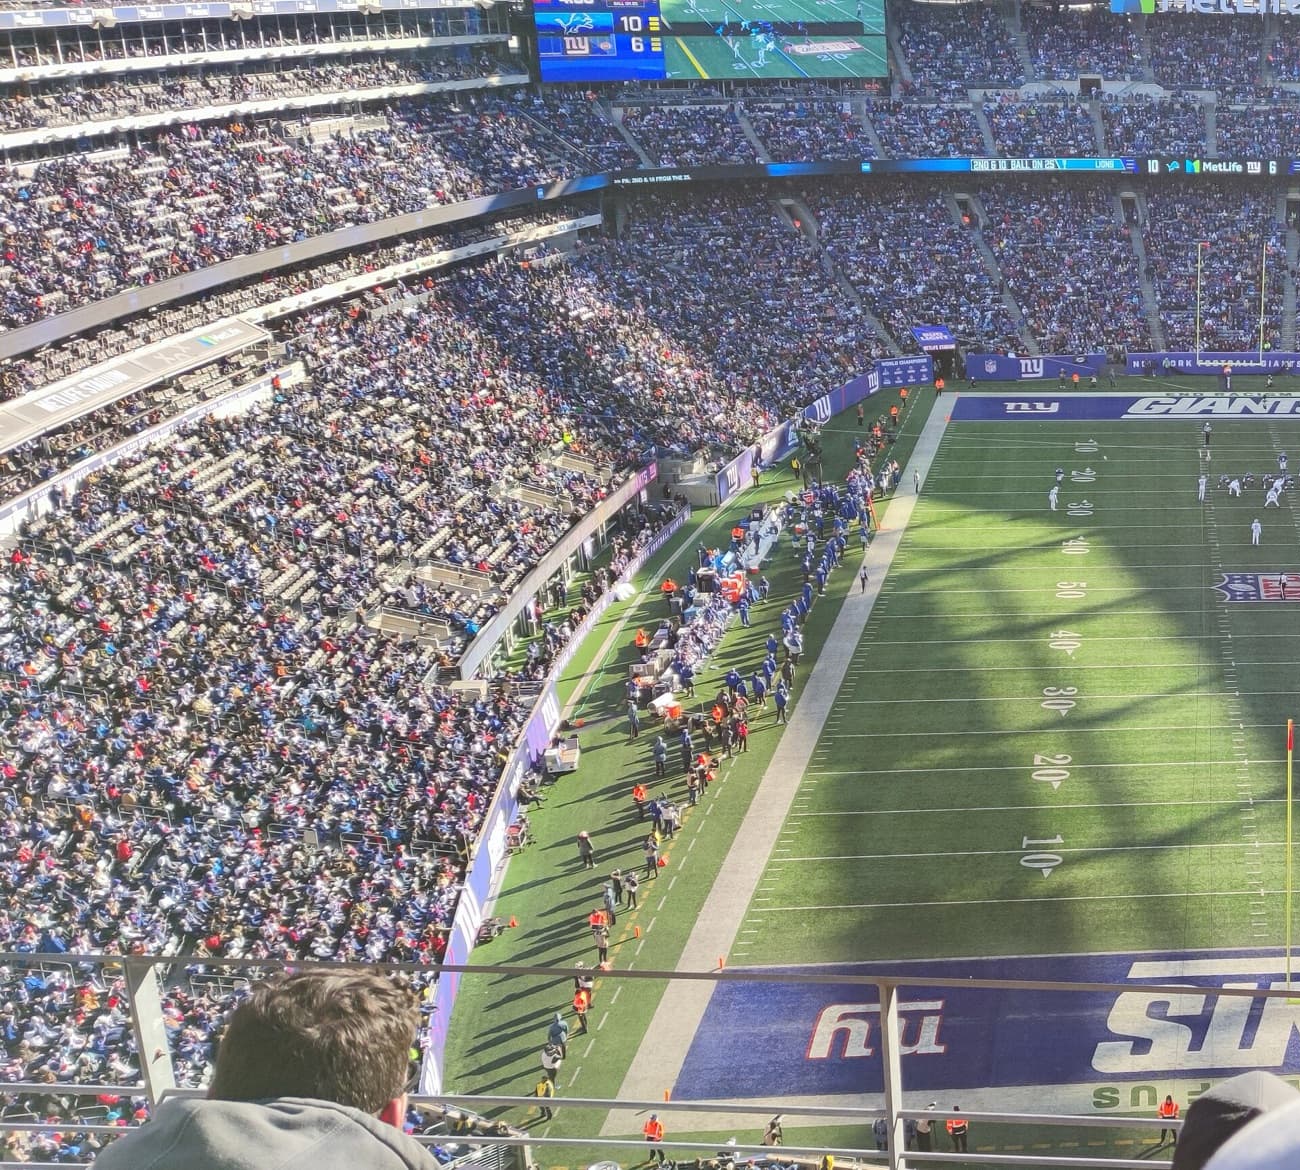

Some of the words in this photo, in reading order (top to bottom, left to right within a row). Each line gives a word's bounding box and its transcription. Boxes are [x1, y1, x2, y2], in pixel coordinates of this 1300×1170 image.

[620, 16, 642, 32] 10
[631, 37, 644, 52] 6
[973, 161, 989, 170] 2ND
[1011, 160, 1029, 170] BALL
[1032, 160, 1042, 170] ON
[1095, 160, 1115, 169] LIONS
[1147, 159, 1159, 173] 10
[1202, 161, 1243, 173] MetLife
[1269, 161, 1277, 174] 6
[1020, 359, 1044, 378] ny
[1003, 401, 1060, 413] ny
[1071, 469, 1097, 482] 20
[1066, 502, 1094, 516] 30
[1061, 538, 1090, 554] 40
[1055, 581, 1087, 598] 50
[1048, 630, 1082, 649] 40
[1041, 686, 1078, 710] 30
[1031, 753, 1073, 782] 20
[1019, 834, 1065, 868] 10
[807, 1000, 946, 1059] ny
[1093, 1085, 1158, 1109] US
